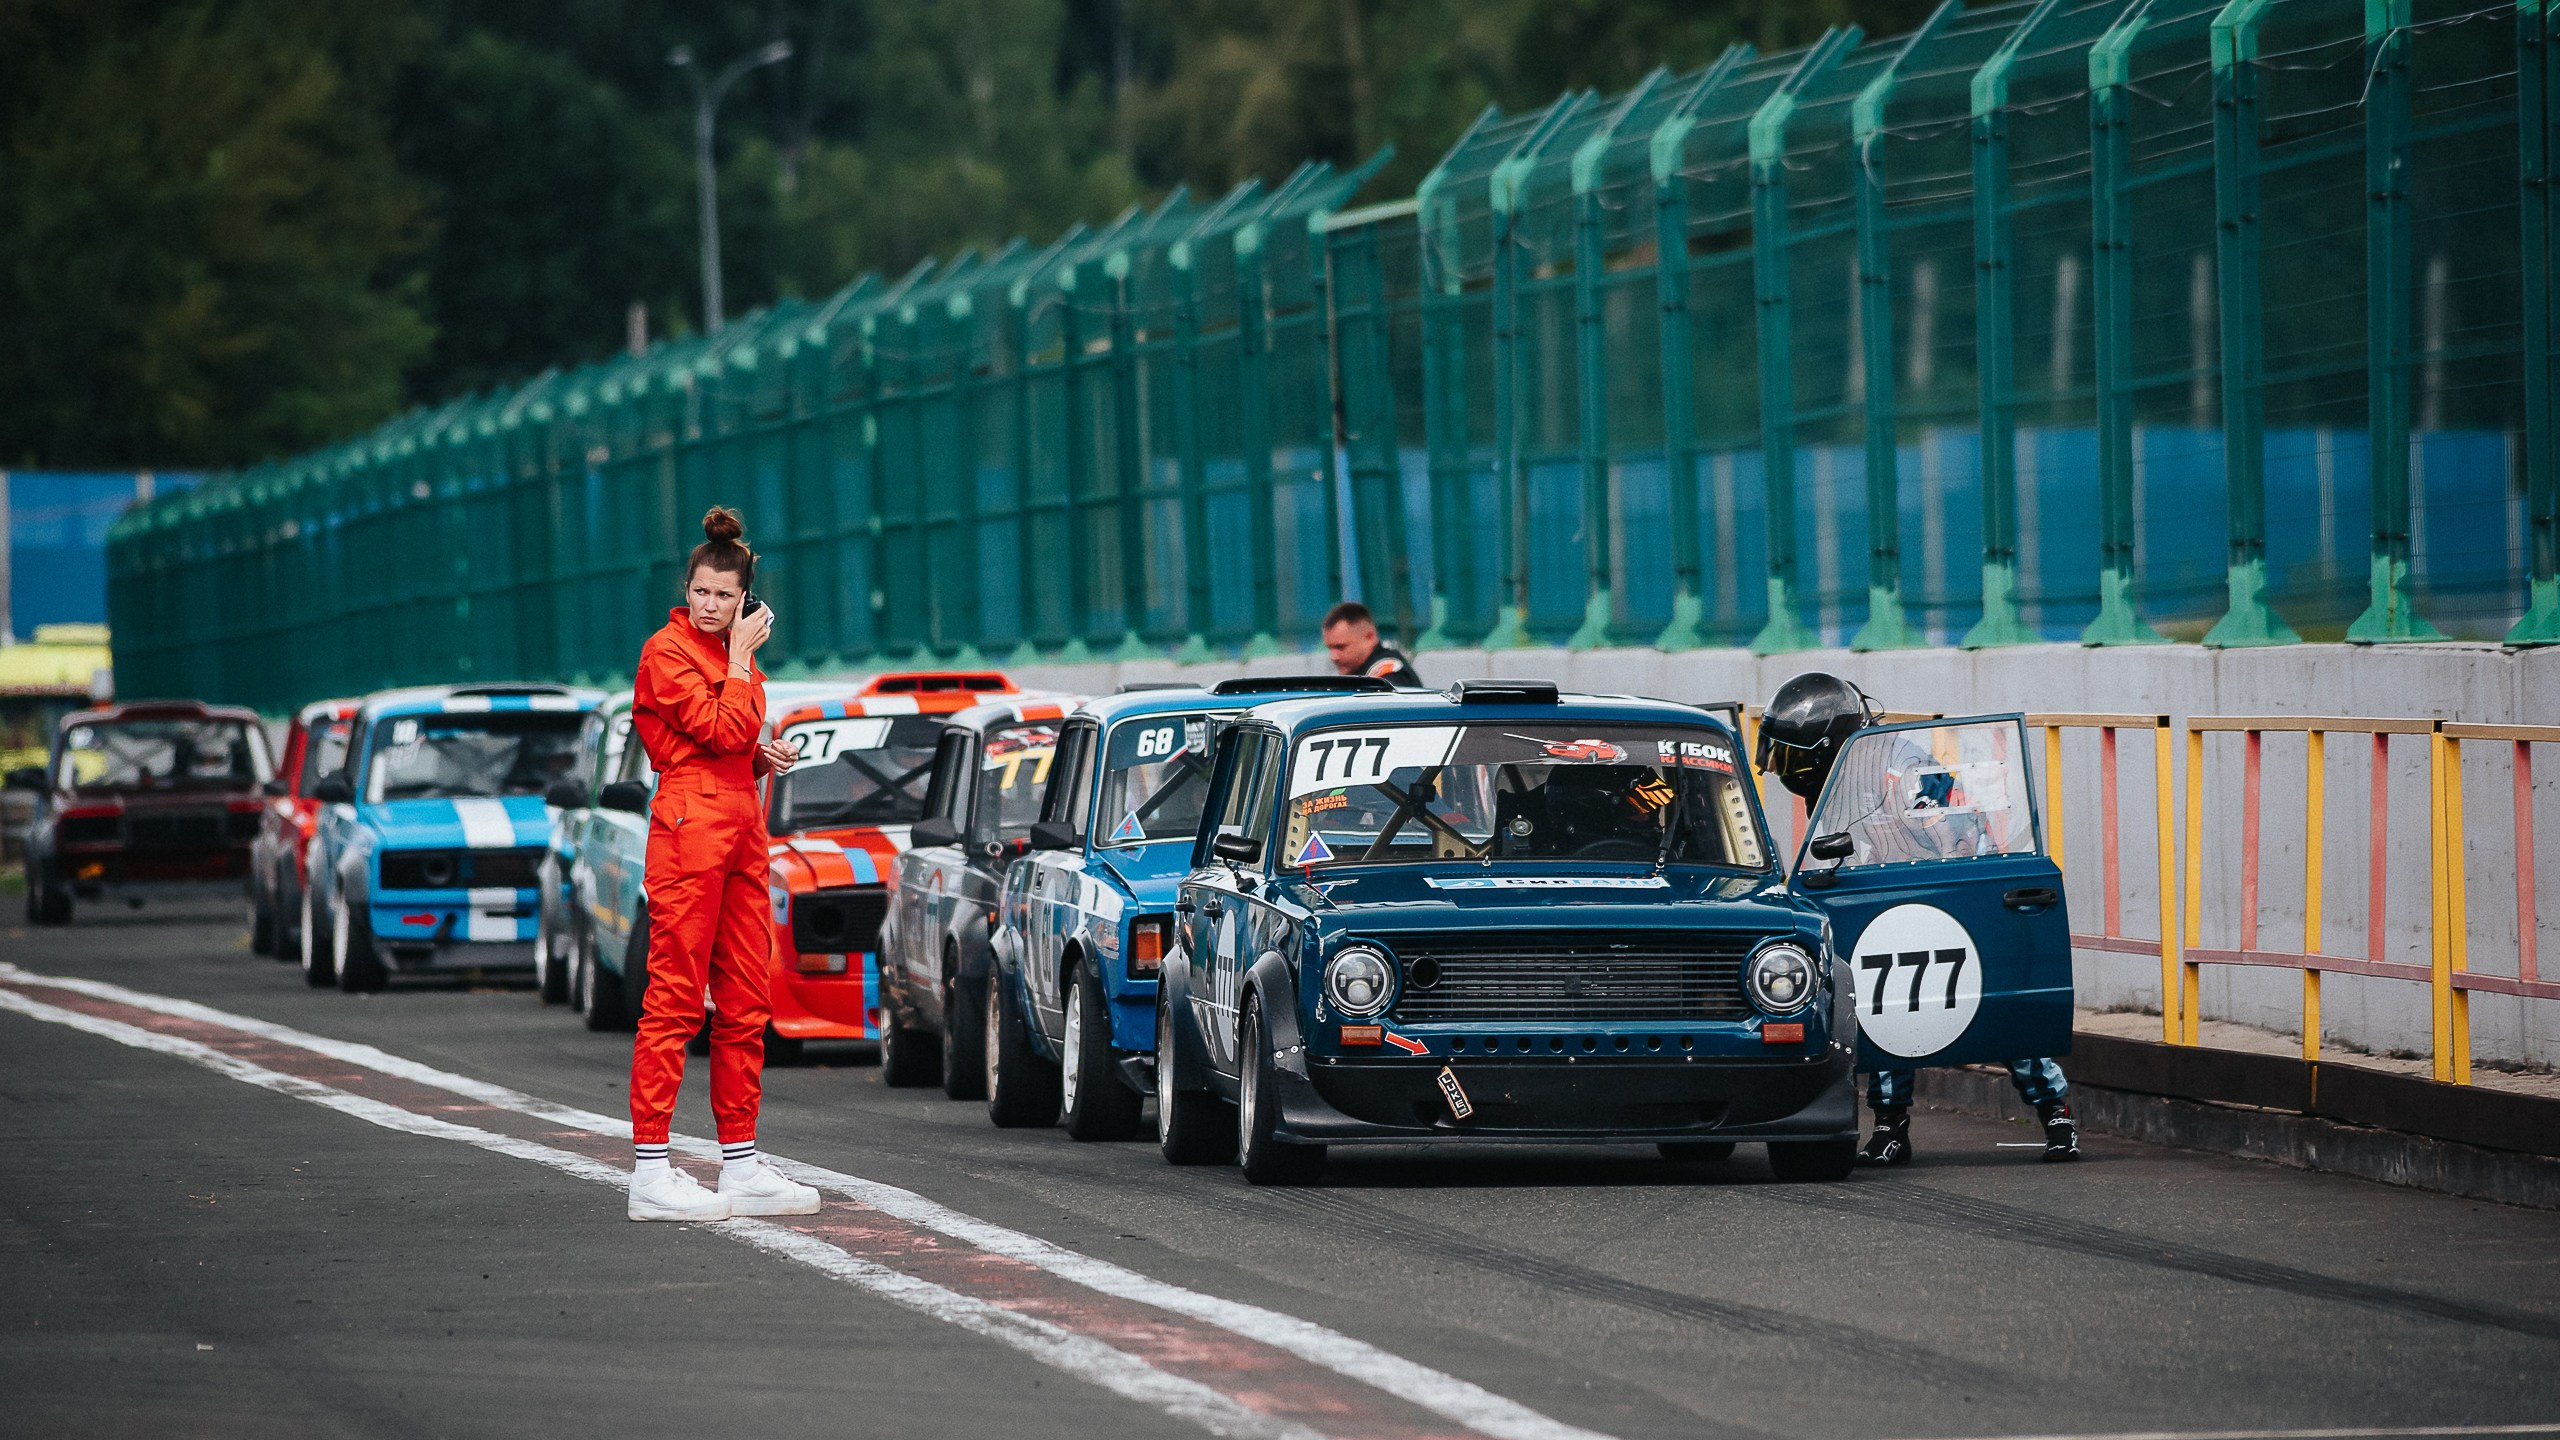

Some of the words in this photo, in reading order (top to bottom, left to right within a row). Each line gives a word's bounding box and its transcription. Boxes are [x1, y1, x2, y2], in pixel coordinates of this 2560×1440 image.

[789, 729, 836, 760] 27
[1136, 727, 1175, 757] 68
[1310, 737, 1390, 781] 777
[1302, 800, 1314, 809] ЗА
[1315, 794, 1348, 806] ЖИЗНЬ
[1313, 801, 1348, 814] ДОРОГАХ
[1217, 955, 1234, 1018] 777
[1860, 947, 1967, 1016] 777
